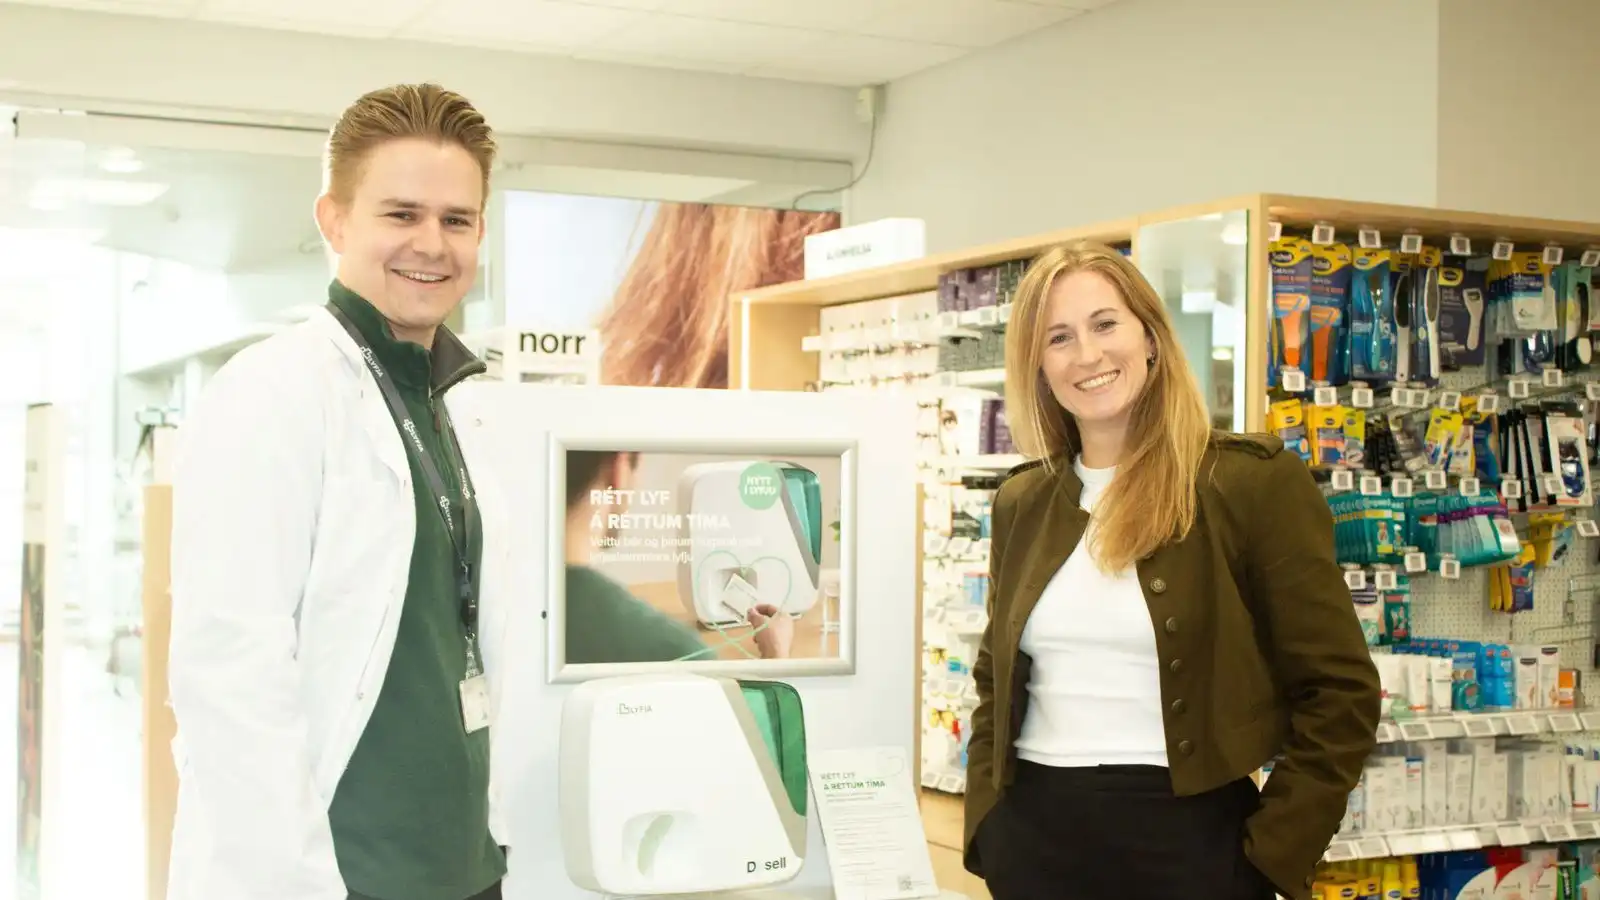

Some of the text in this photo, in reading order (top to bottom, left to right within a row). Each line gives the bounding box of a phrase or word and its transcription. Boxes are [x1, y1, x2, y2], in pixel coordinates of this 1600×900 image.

[520, 332, 586, 354] norr
[590, 485, 671, 505] RÉTT LYF
[590, 510, 732, 529] Á RÉTTUM TÍMA
[590, 535, 620, 547] Veittu
[644, 538, 658, 549] og
